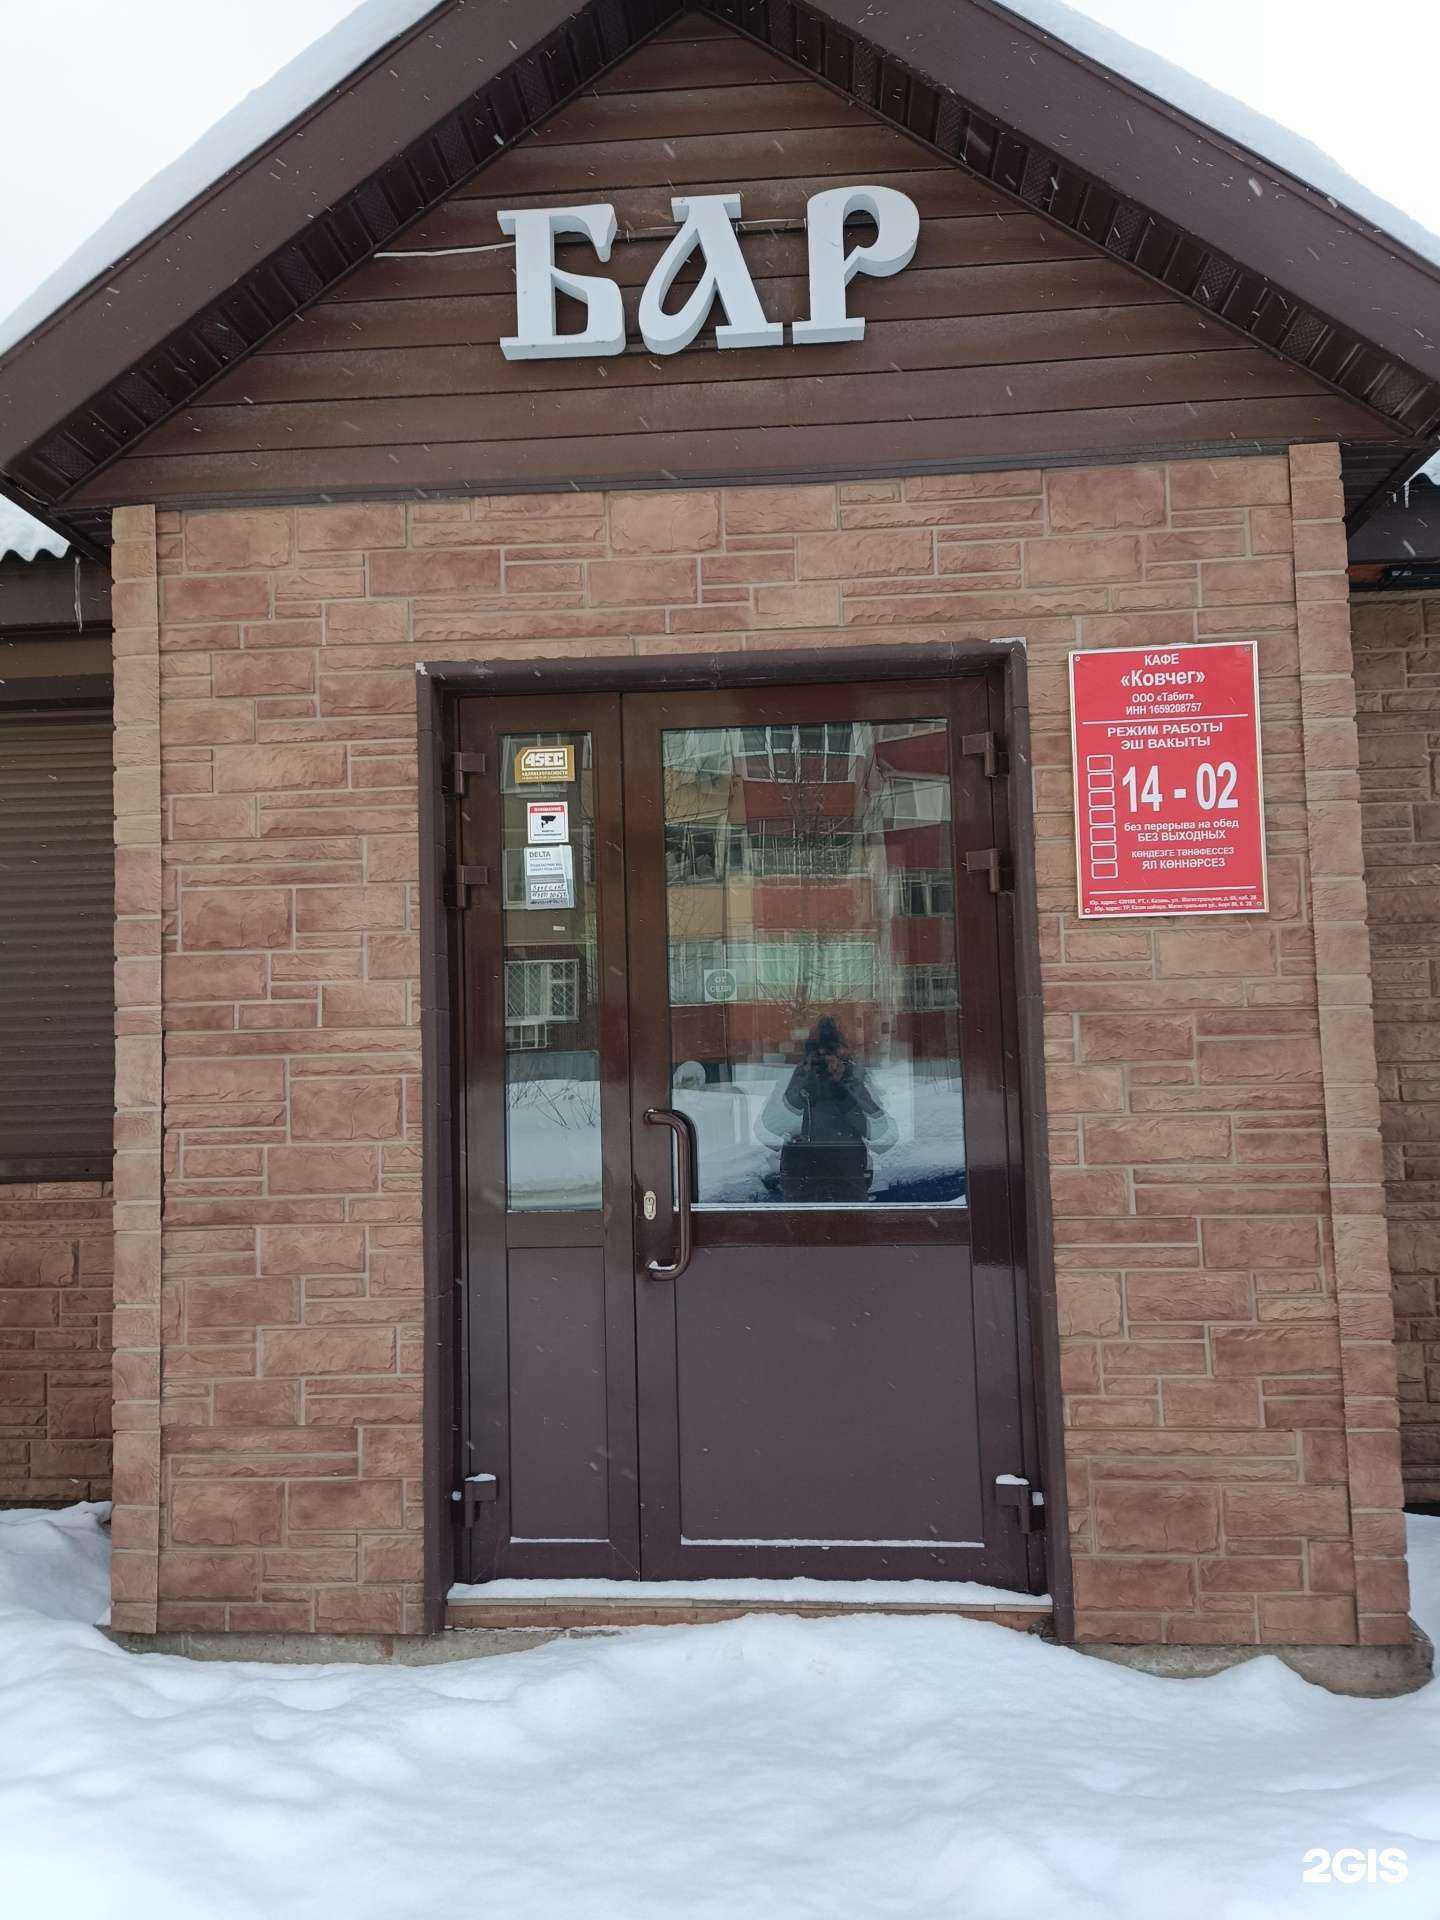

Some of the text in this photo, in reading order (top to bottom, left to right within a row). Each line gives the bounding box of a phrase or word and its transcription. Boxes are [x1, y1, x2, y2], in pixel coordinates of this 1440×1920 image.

[497, 185, 920, 361] БАР
[1144, 653, 1180, 666] КАФЕ
[1120, 669, 1206, 687] «Ковчег»
[1131, 691, 1196, 703] ООО «Табит»
[1125, 704, 1147, 715] ИНН
[1107, 722, 1223, 738] РЕЖИМ РАБОТЫ
[1120, 736, 1211, 750] ЭШ ВАКЫТЫ
[1122, 761, 1239, 813] 14 - 02
[1123, 818, 1240, 833] без перерыва на обед
[1137, 830, 1227, 842] БЕЗ ВЫХОДНЫХ
